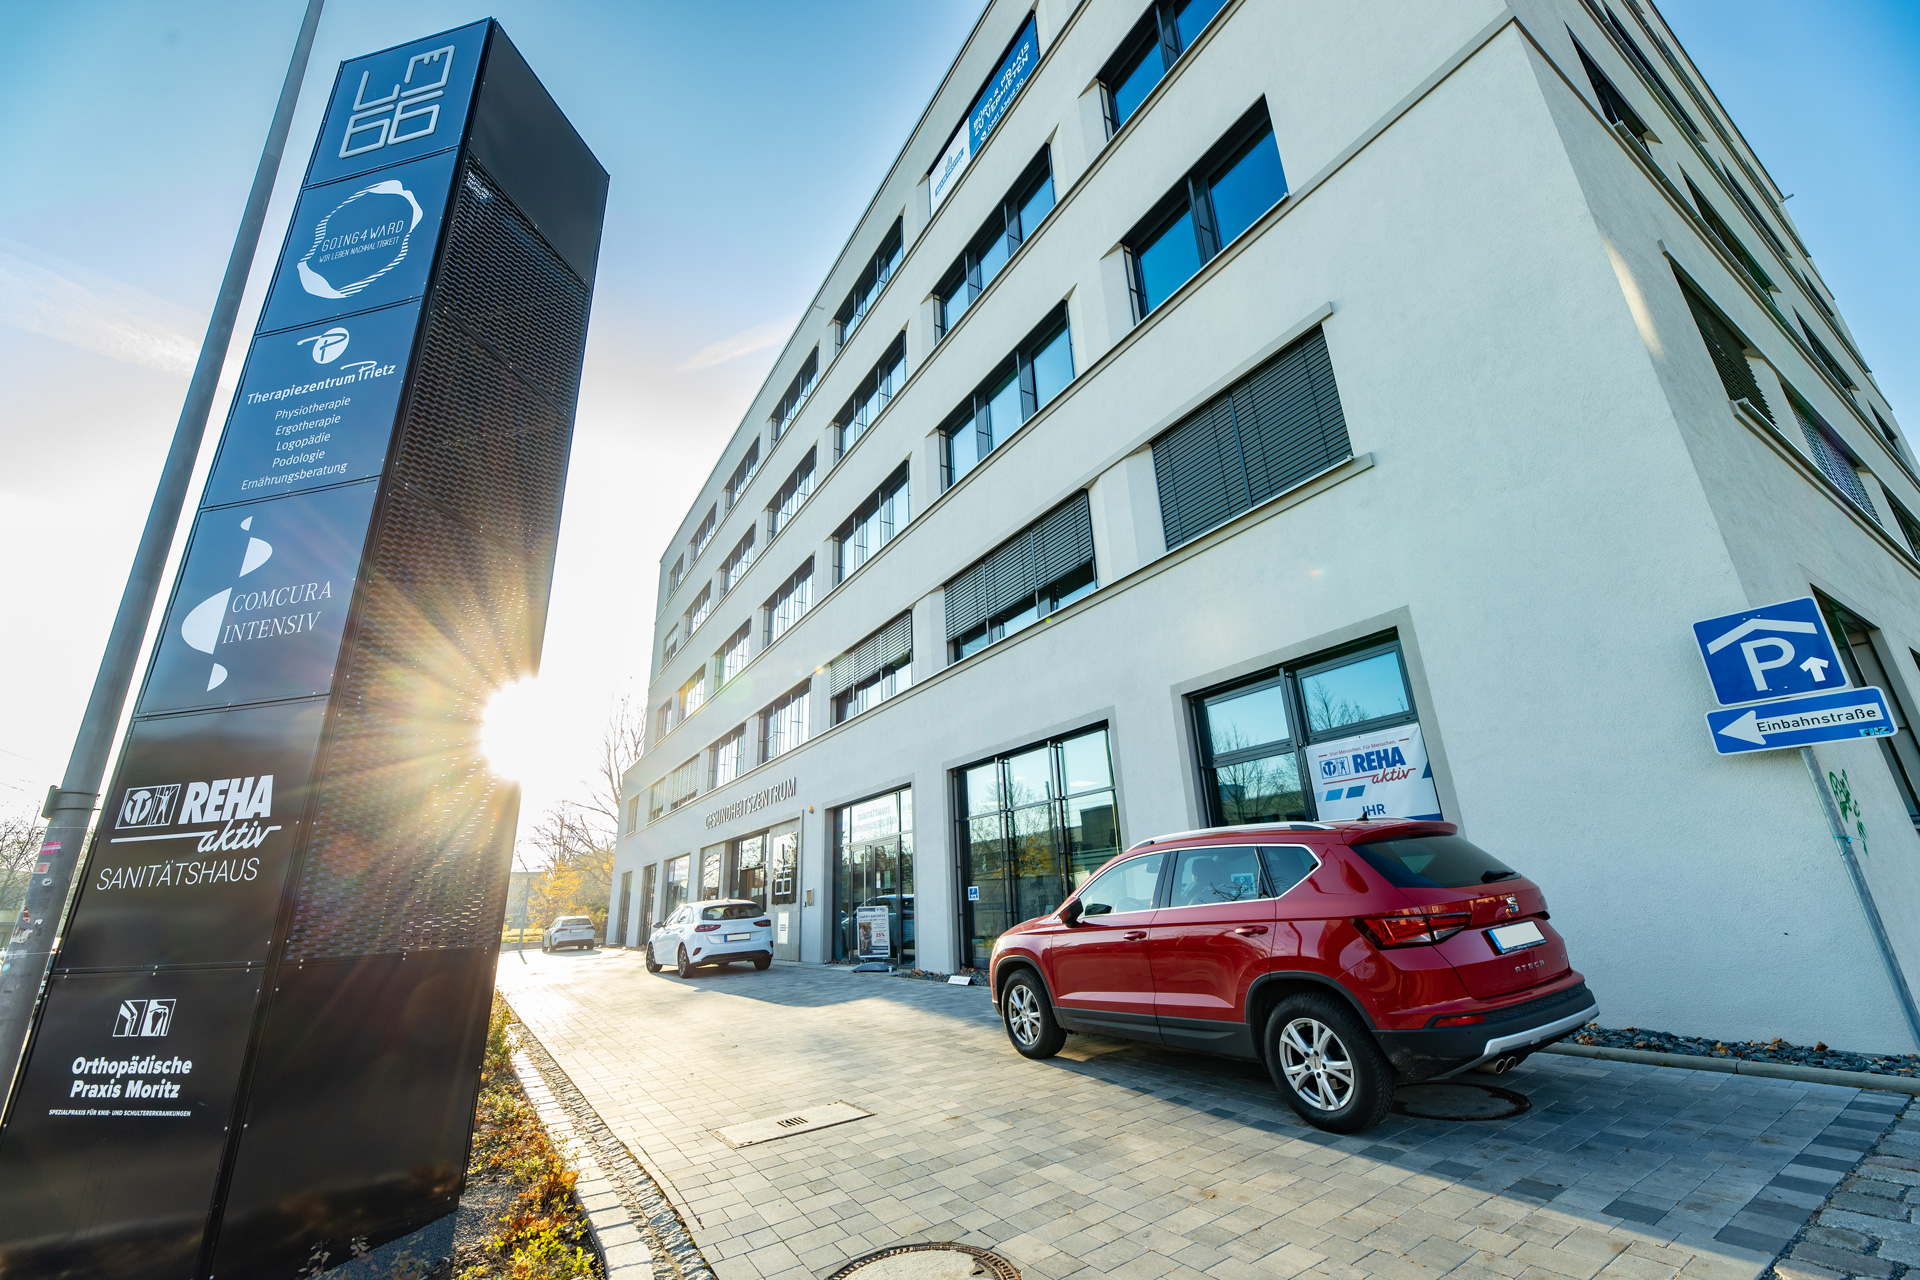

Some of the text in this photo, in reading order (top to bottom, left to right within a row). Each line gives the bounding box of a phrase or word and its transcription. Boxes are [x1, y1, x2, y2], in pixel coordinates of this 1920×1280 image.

[973, 41, 1030, 130] BÜRO & PRAXIS
[974, 52, 1029, 137] ZU VERMIETEN
[318, 235, 400, 264] WIR LEBEN NACHHALTIGKEIT
[321, 219, 404, 252] GOING4WARD
[247, 373, 356, 405] Therapiezentrum
[274, 396, 351, 421] Physiotherapie
[275, 413, 341, 437] Ergotherapie
[275, 431, 331, 452] Logopädie
[271, 448, 326, 469] Podologie
[240, 461, 349, 491] Ernährungsberatung
[231, 580, 333, 613] COMCURA
[221, 611, 322, 645] INTENSIV
[1740, 636, 1796, 692] P
[1755, 707, 1877, 733] Einbahnstraße
[1352, 746, 1407, 774] REHA
[1371, 767, 1417, 785] aktiv
[177, 774, 275, 825] REHA
[705, 776, 797, 830] GESUNDHEITSZENTRUM
[1362, 803, 1387, 817] IHR
[197, 818, 283, 853] aktiv
[96, 856, 261, 891] SANITÄTSHAUS
[1514, 959, 1545, 973] ATECA
[71, 1055, 193, 1079] Orthopädische
[69, 1078, 181, 1099] Praxis Moritz
[86, 1108, 98, 1116] FÜR
[111, 1109, 124, 1117] UND
[123, 1109, 192, 1117] SCHULTERERKRANKUNGEN
